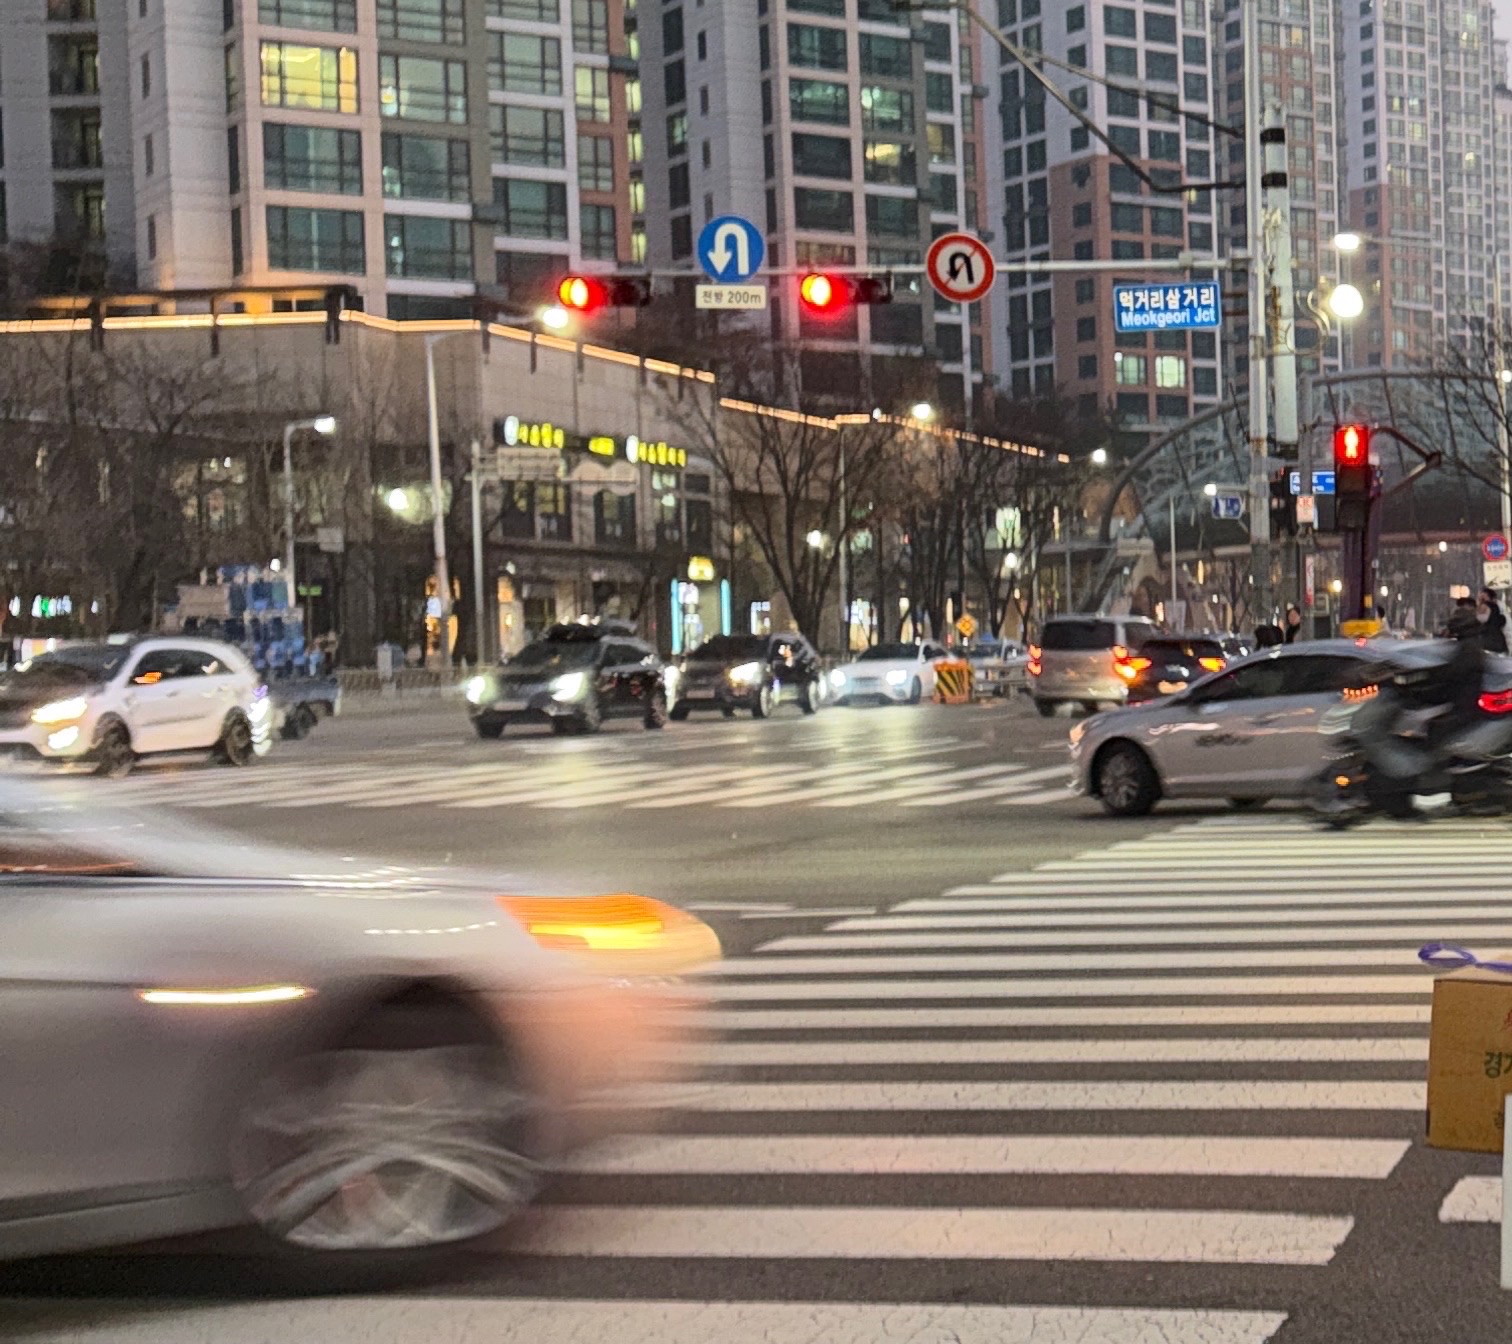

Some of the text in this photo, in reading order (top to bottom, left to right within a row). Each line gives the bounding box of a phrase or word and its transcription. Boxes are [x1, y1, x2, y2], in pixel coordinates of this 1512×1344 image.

[702, 290, 762, 304] 전방 200m
[1119, 286, 1215, 312] 먹거리삼거리
[1121, 307, 1216, 328] Meokgeori Jct
